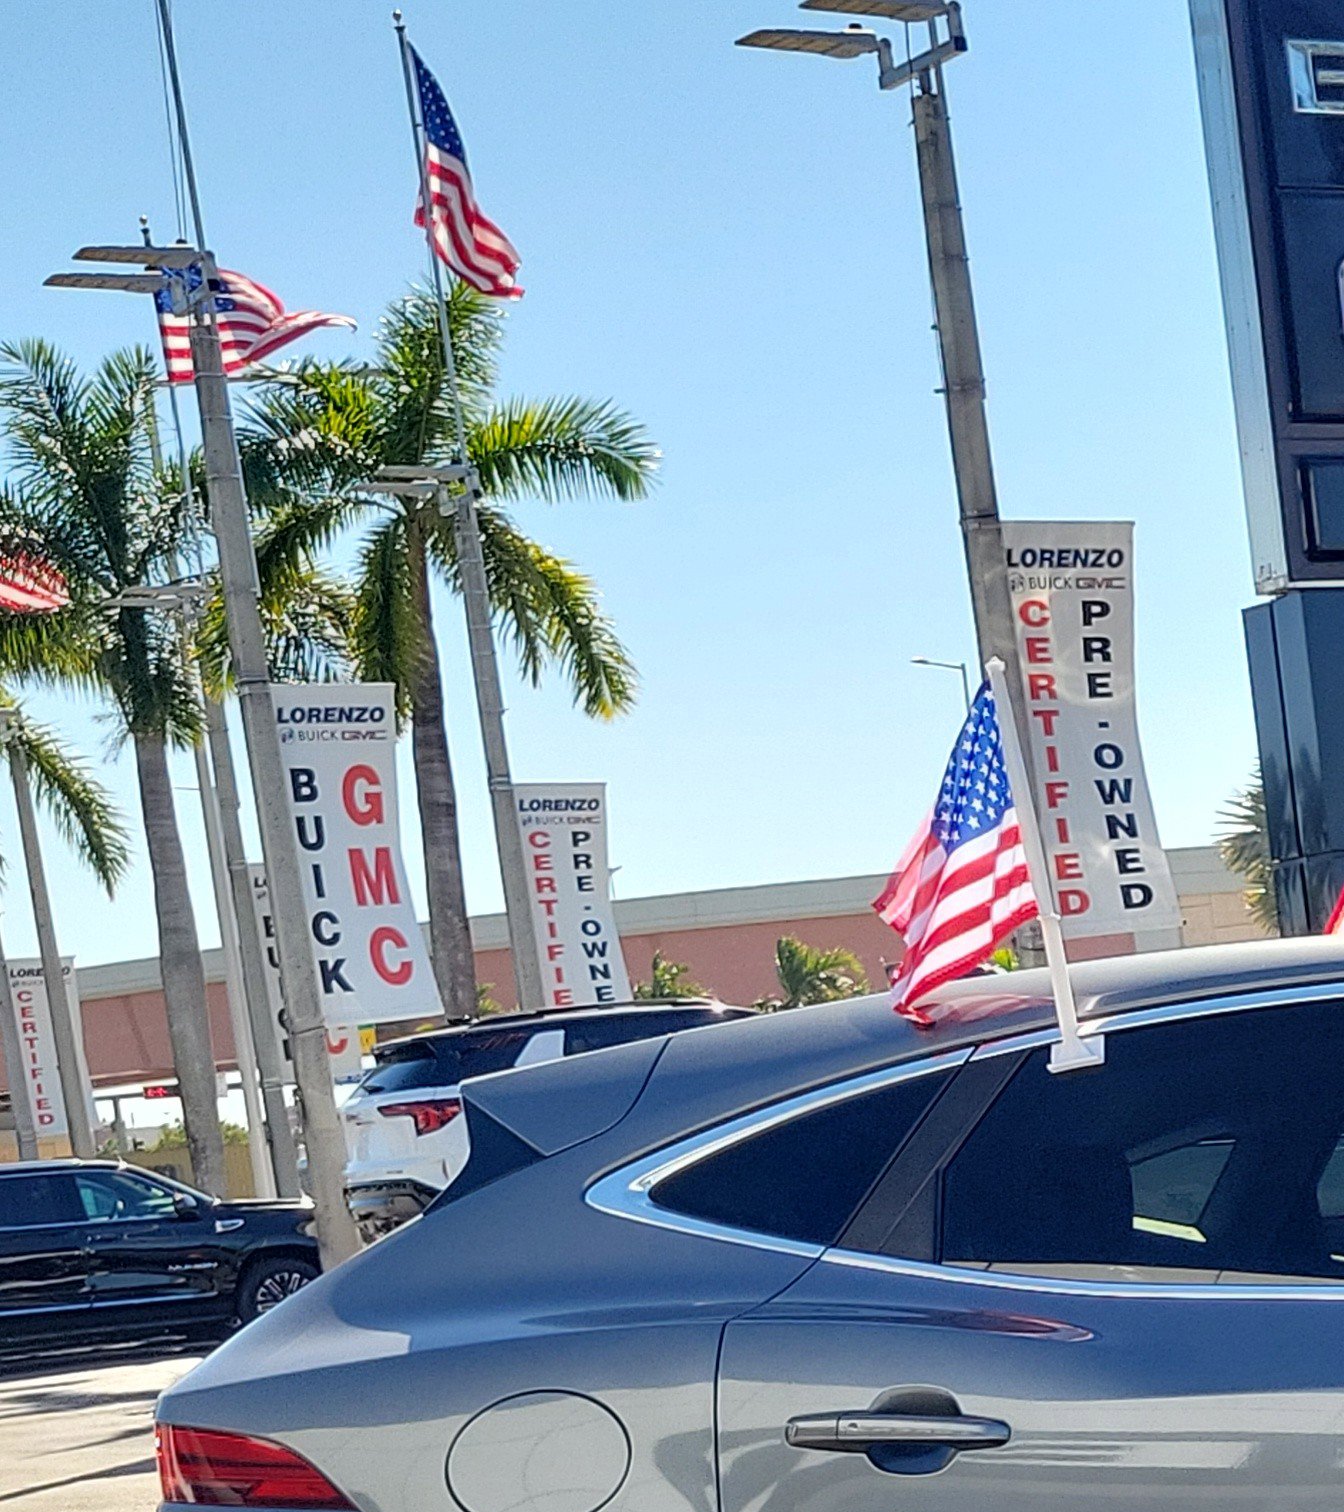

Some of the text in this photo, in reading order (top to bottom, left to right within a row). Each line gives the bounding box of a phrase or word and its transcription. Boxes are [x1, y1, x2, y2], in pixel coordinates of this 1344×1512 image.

[1006, 548, 1125, 569] LORENZO
[1028, 576, 1126, 590] BUICK GMC
[277, 706, 385, 724] LORENZO
[298, 729, 387, 741] BUICK GMC
[1018, 600, 1090, 916] CERTIFIED
[1081, 600, 1153, 911] PRE-OWNED
[519, 798, 600, 812] LORENZO
[289, 768, 354, 994] BUICK
[342, 764, 414, 986] GMC
[528, 831, 574, 1005] CERTIFIE
[571, 831, 616, 1002] PRE-OWNE
[10, 966, 71, 978] LOREO
[17, 991, 54, 1125] CERTIFIED
